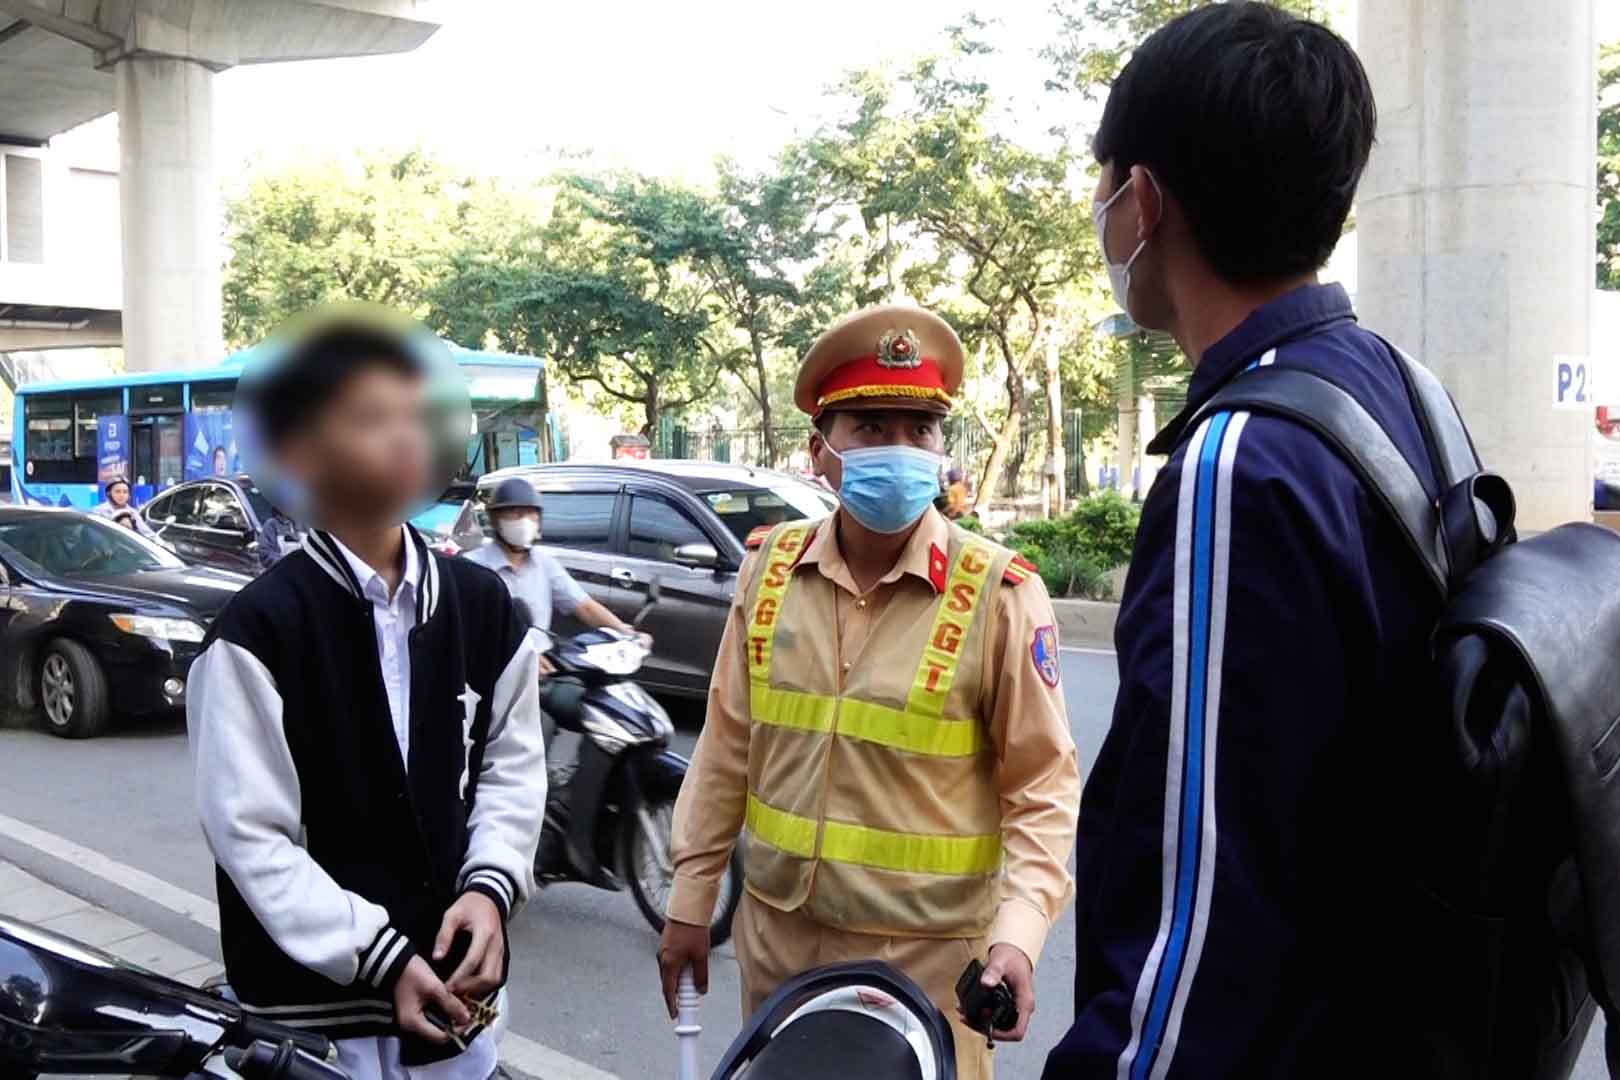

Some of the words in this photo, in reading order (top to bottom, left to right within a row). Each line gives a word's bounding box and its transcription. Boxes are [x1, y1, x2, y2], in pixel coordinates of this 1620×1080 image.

[1558, 362, 1592, 402] P2
[751, 528, 803, 666] CSGT
[925, 547, 989, 692] CSGT
